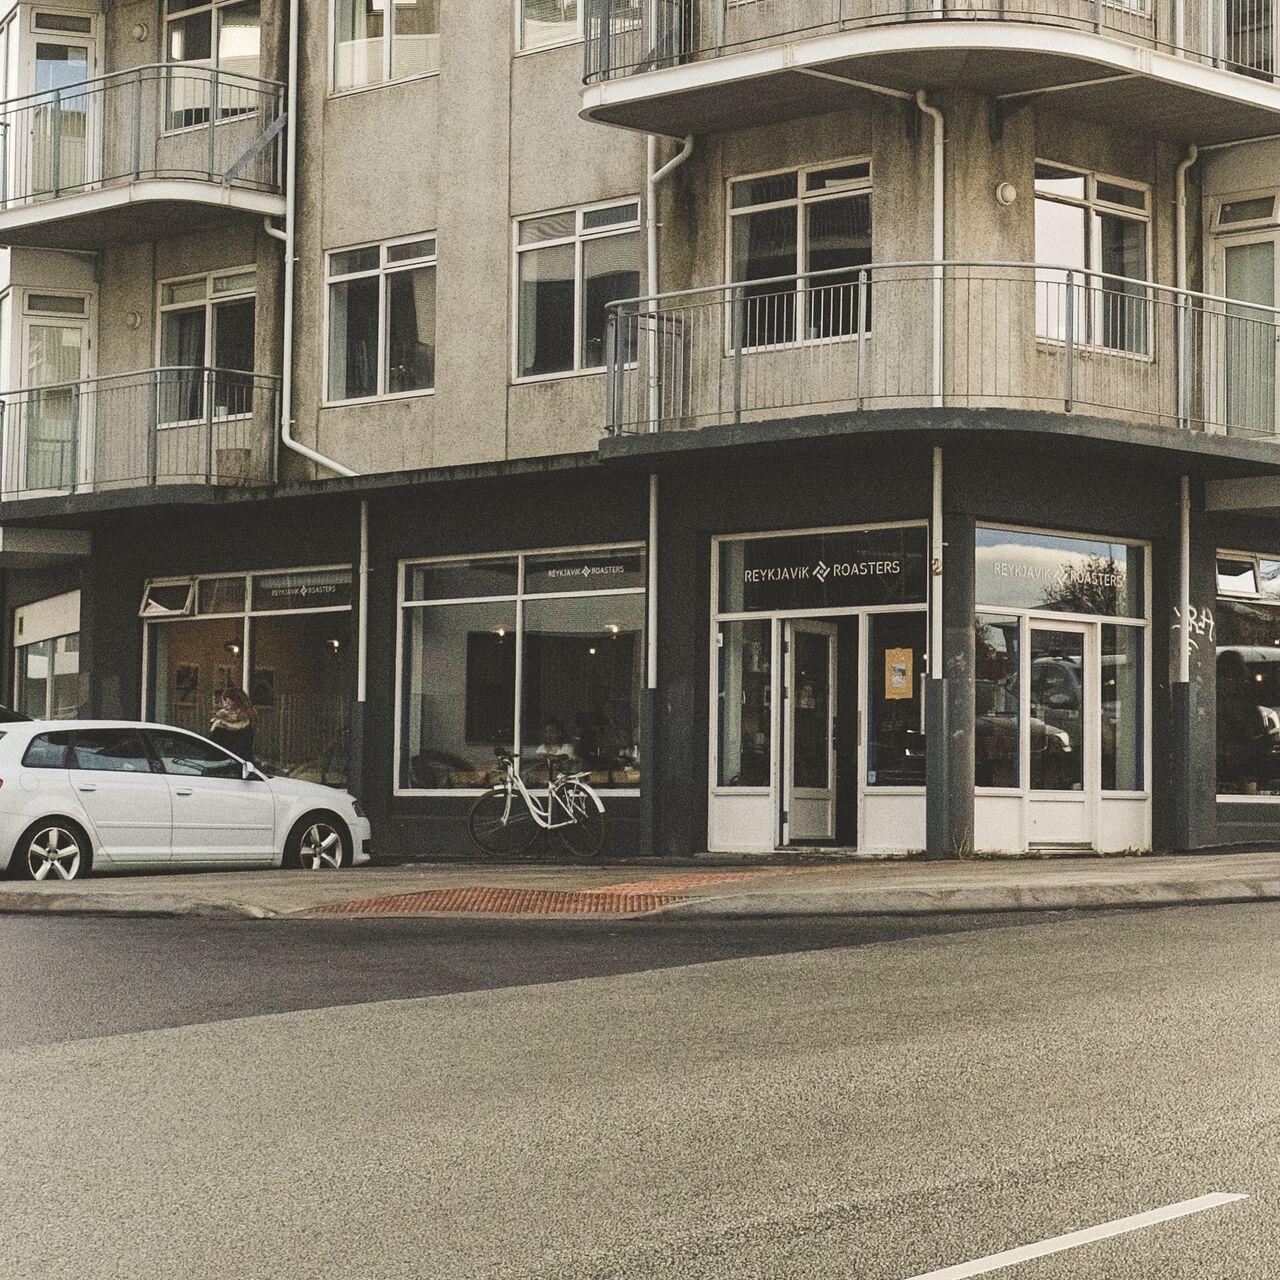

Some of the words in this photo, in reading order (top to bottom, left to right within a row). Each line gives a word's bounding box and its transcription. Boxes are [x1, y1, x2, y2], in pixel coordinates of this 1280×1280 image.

[591, 565, 625, 574] ROASTERS
[833, 560, 900, 577] ROASTERS
[1070, 570, 1123, 587] ROASTERS
